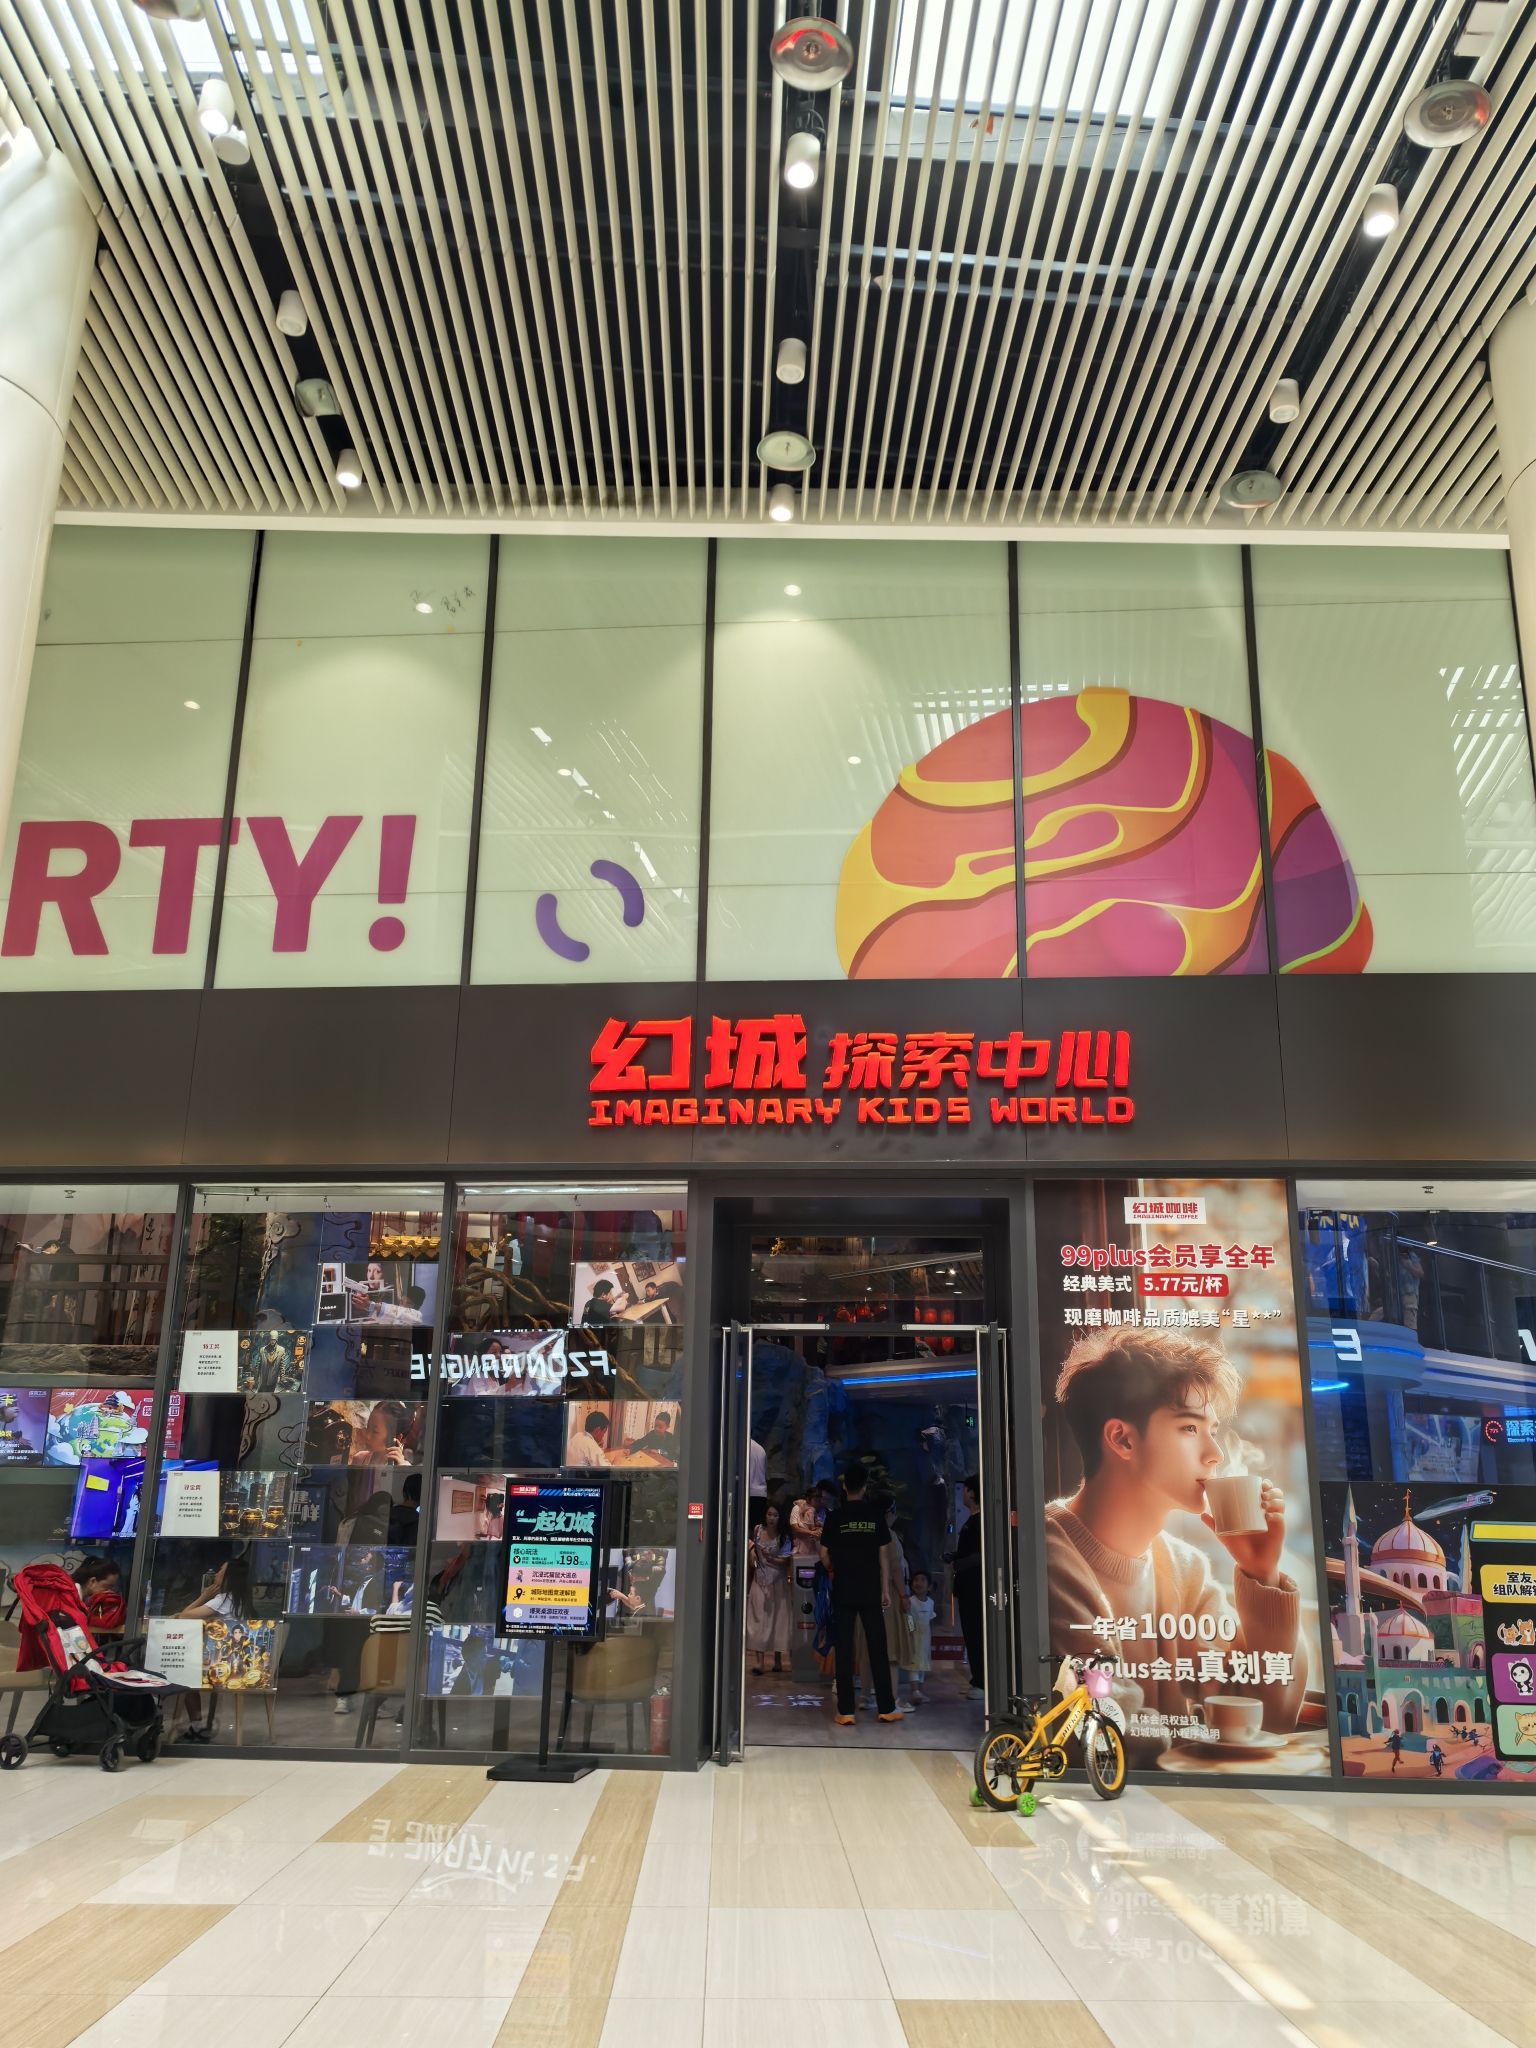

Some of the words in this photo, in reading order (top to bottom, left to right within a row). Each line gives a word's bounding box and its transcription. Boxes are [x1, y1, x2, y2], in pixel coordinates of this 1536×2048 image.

[1, 814, 417, 957] RTY!
[588, 1098, 841, 1126] IMAGINARY
[857, 1097, 971, 1124] KIDS
[990, 1096, 1135, 1124] WORLD
[1132, 1202, 1198, 1214] 幻城咖啡
[1061, 1244, 1276, 1270] 99plus会员享全年
[1063, 1275, 1132, 1293] 经典美式
[1143, 1275, 1223, 1295] 5.77元/杯
[1493, 1583, 1536, 1597] 组队解
[1070, 1613, 1238, 1642] 一年省10000
[1130, 1713, 1200, 1726] 具体会员权益见
